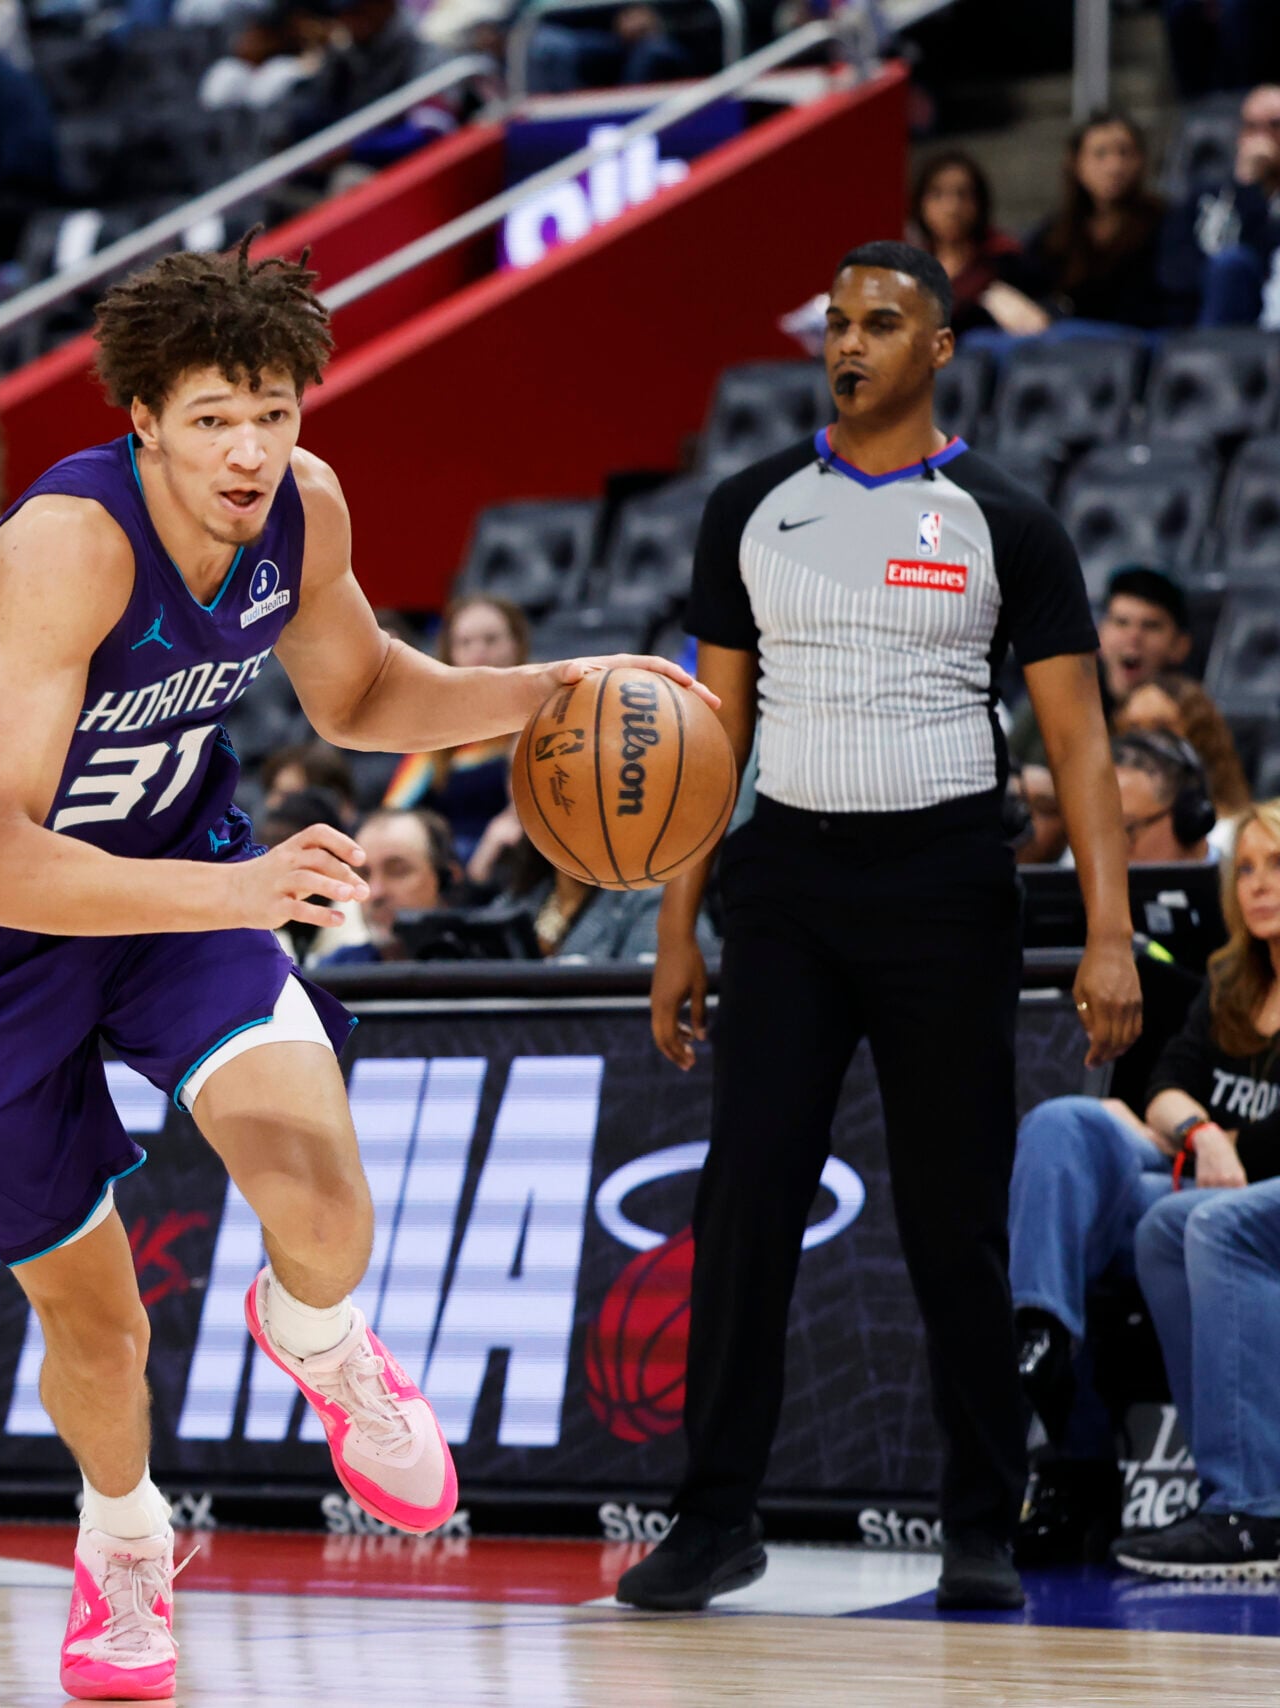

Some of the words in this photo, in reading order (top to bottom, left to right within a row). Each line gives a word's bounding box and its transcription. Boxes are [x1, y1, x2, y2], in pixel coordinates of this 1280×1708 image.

[888, 563, 965, 588] Emirates
[53, 724, 218, 832] 31
[618, 681, 660, 818] Wilson
